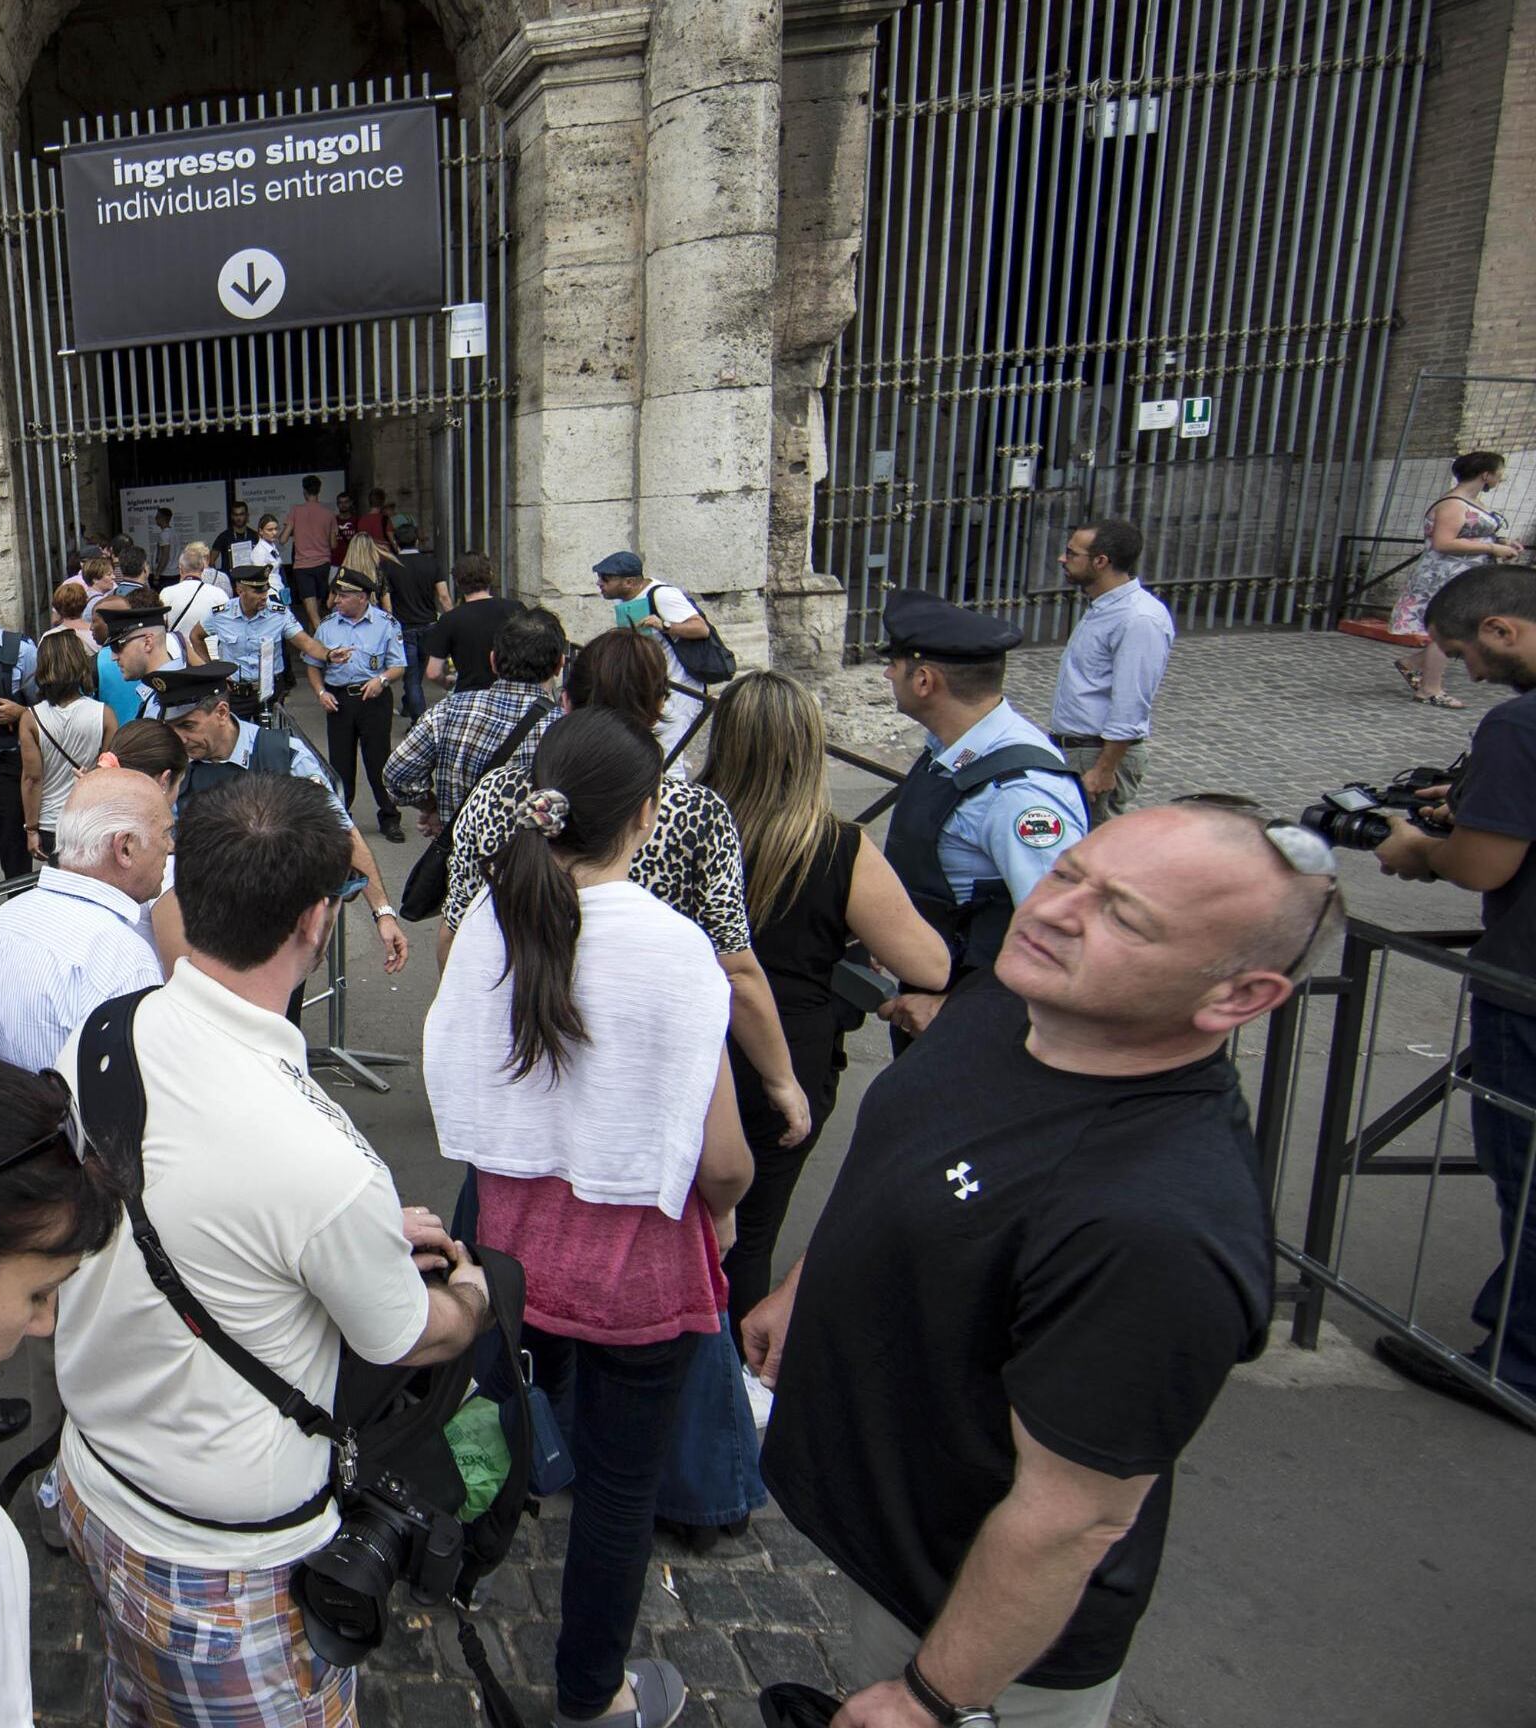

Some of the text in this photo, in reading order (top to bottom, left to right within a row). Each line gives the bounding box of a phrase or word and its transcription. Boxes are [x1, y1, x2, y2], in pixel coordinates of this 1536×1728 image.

[113, 123, 382, 187] ingresso singoli
[97, 165, 404, 225] individuals entrance
